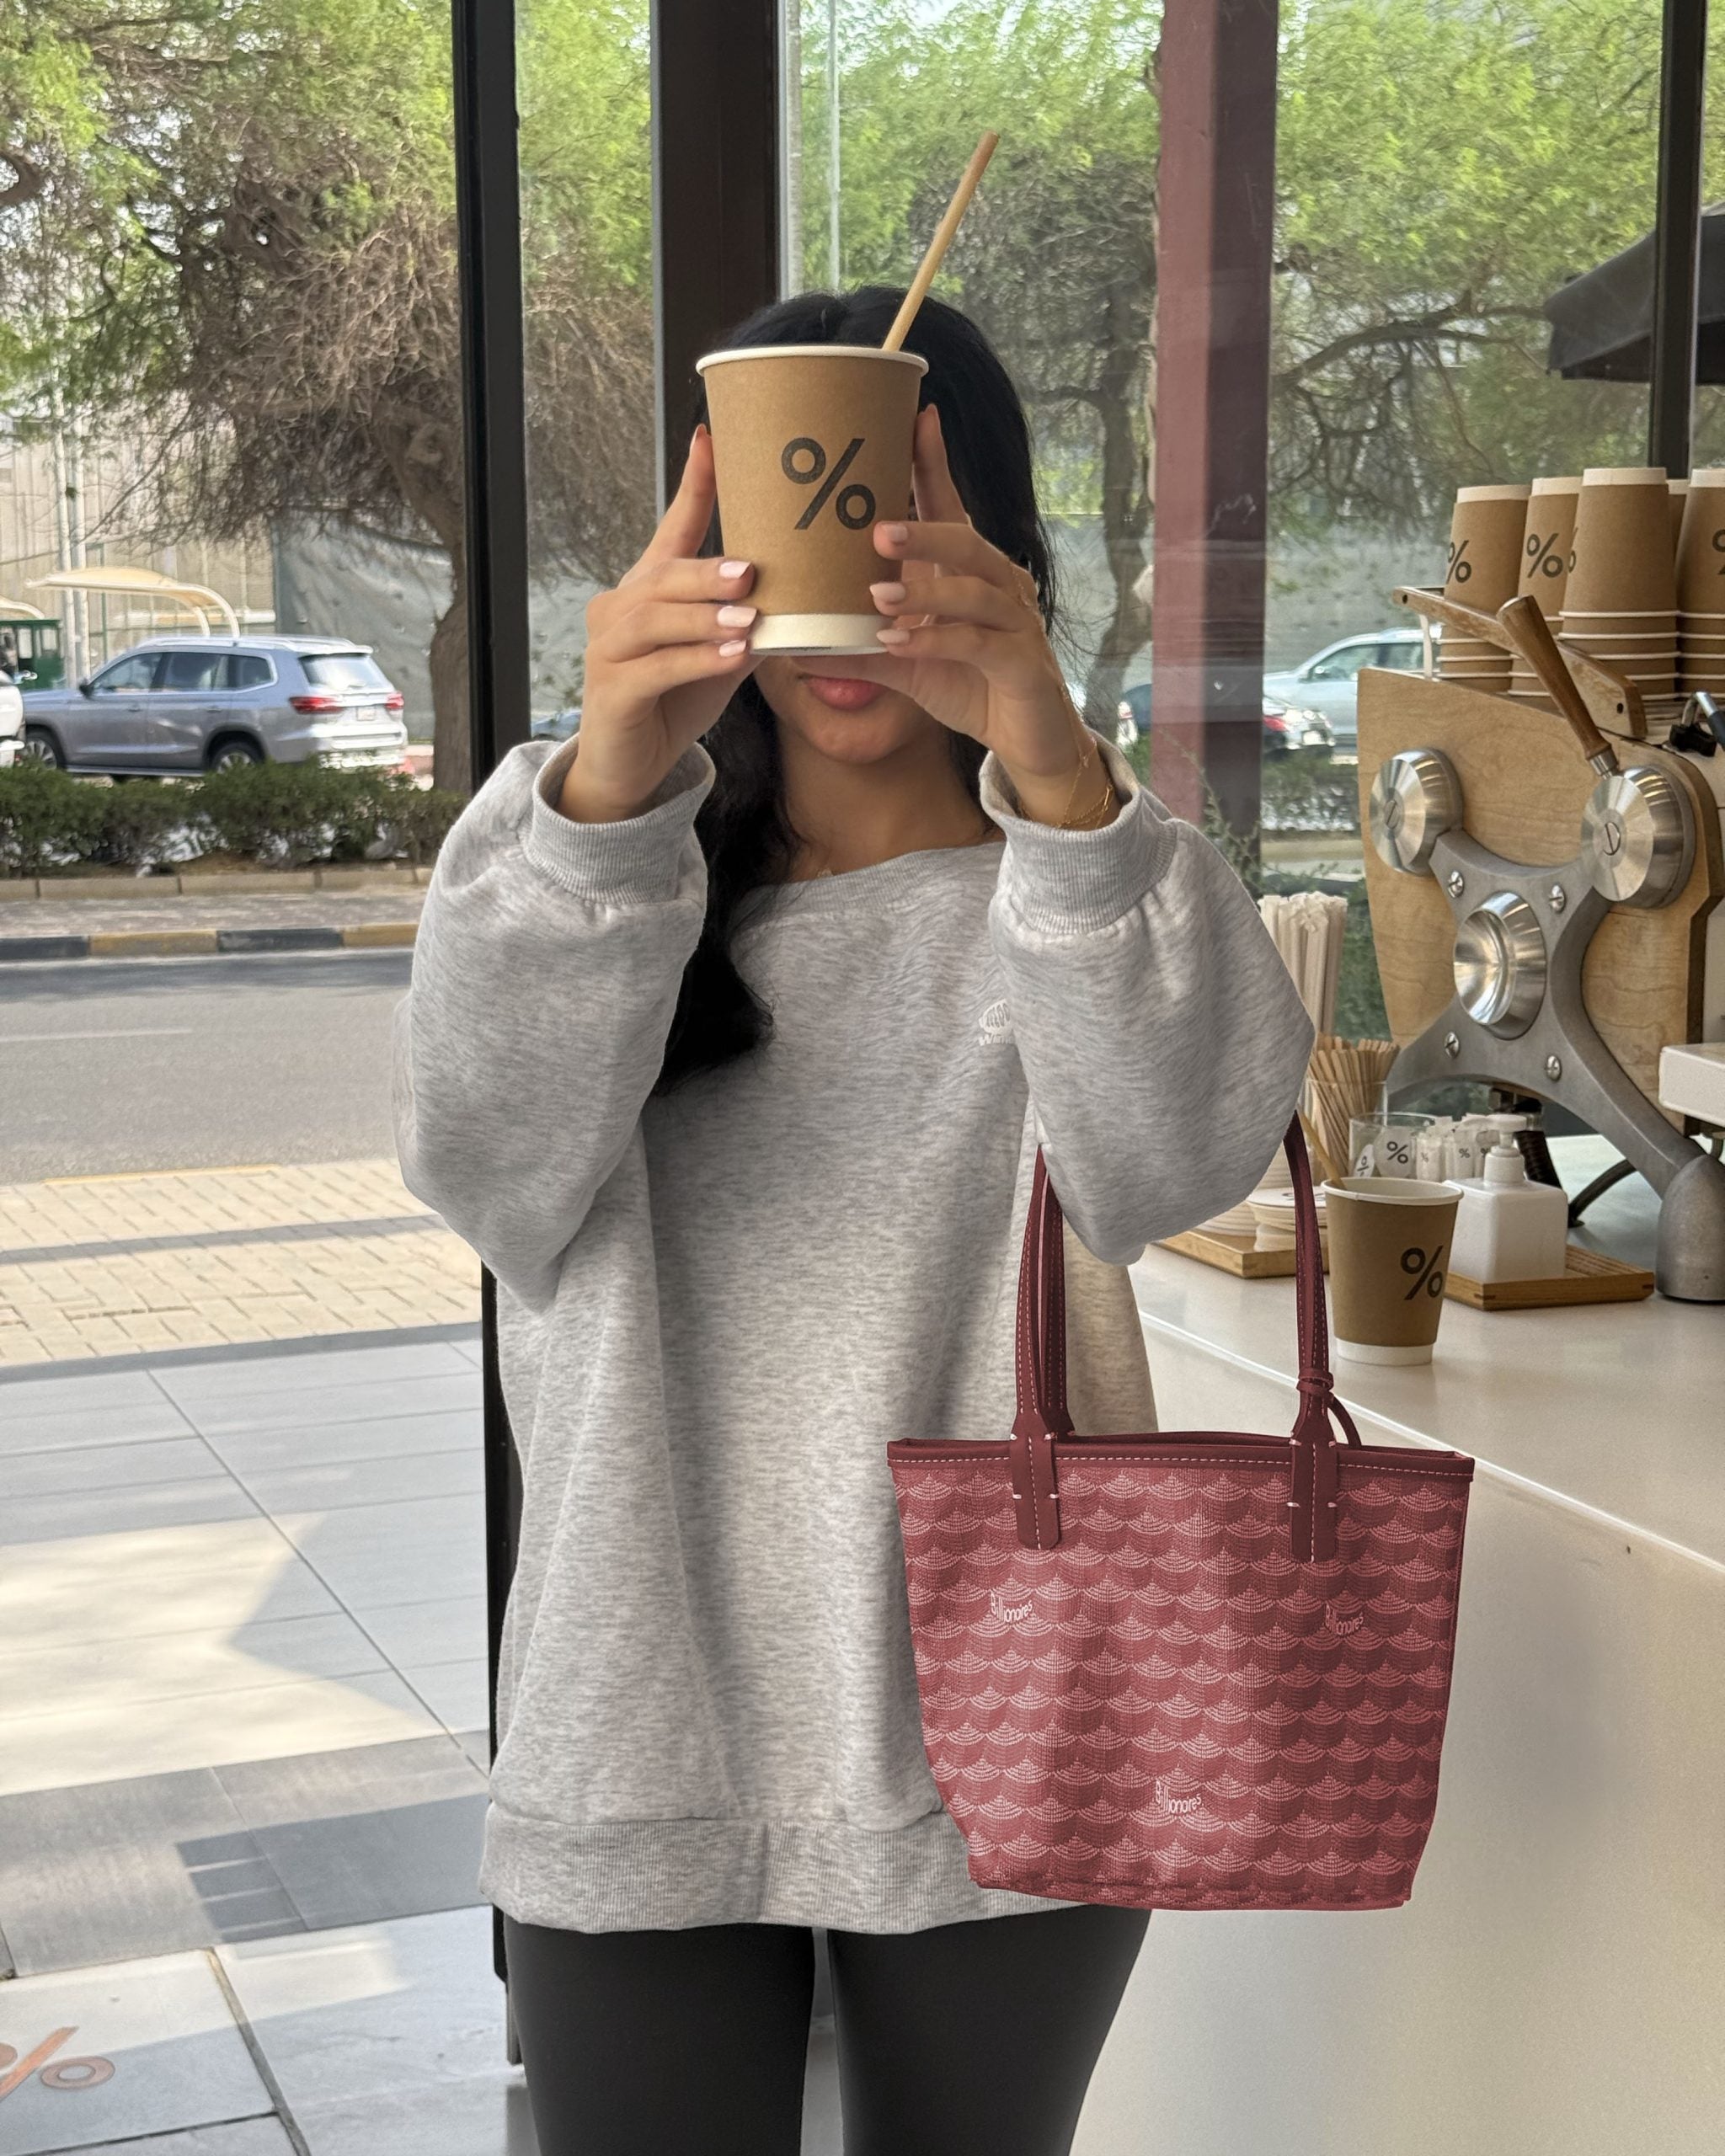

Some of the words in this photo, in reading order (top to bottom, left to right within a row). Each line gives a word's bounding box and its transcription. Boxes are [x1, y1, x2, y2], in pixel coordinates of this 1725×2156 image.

[782, 437, 876, 531] %
[1527, 533, 1563, 579] %
[1386, 1141, 1409, 1164] %
[1400, 1245, 1444, 1300] %
